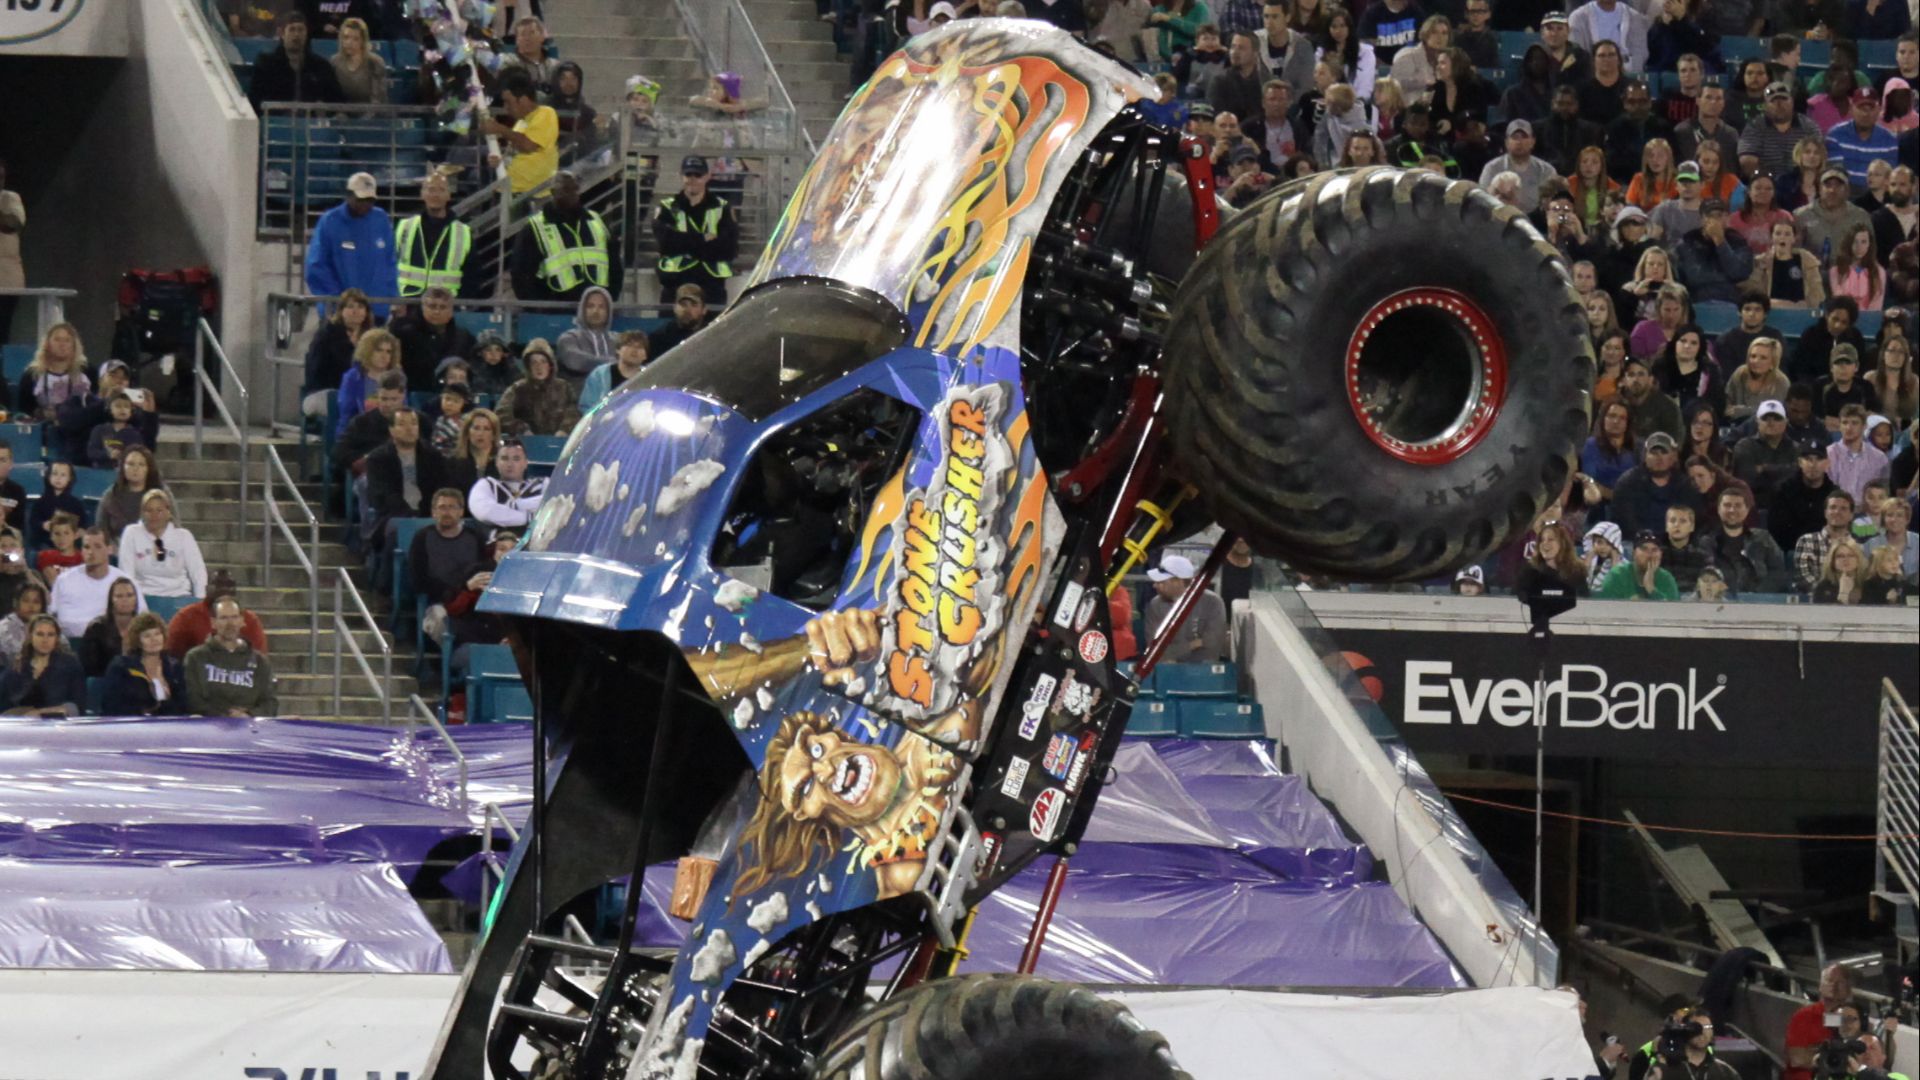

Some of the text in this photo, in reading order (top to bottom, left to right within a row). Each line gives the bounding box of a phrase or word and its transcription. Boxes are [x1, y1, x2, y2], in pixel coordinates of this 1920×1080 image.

[320, 1, 351, 13] HEAT
[1424, 443, 1528, 506] YEAR
[938, 399, 987, 643] CRUSHER
[888, 499, 943, 710] STONE
[205, 663, 254, 688] TITANS
[1041, 680, 1054, 701] ENDS
[1032, 684, 1045, 702] ROD
[1403, 660, 1728, 731] EverBank
[1021, 713, 1039, 737] FK
[1064, 750, 1088, 792] HAWK
